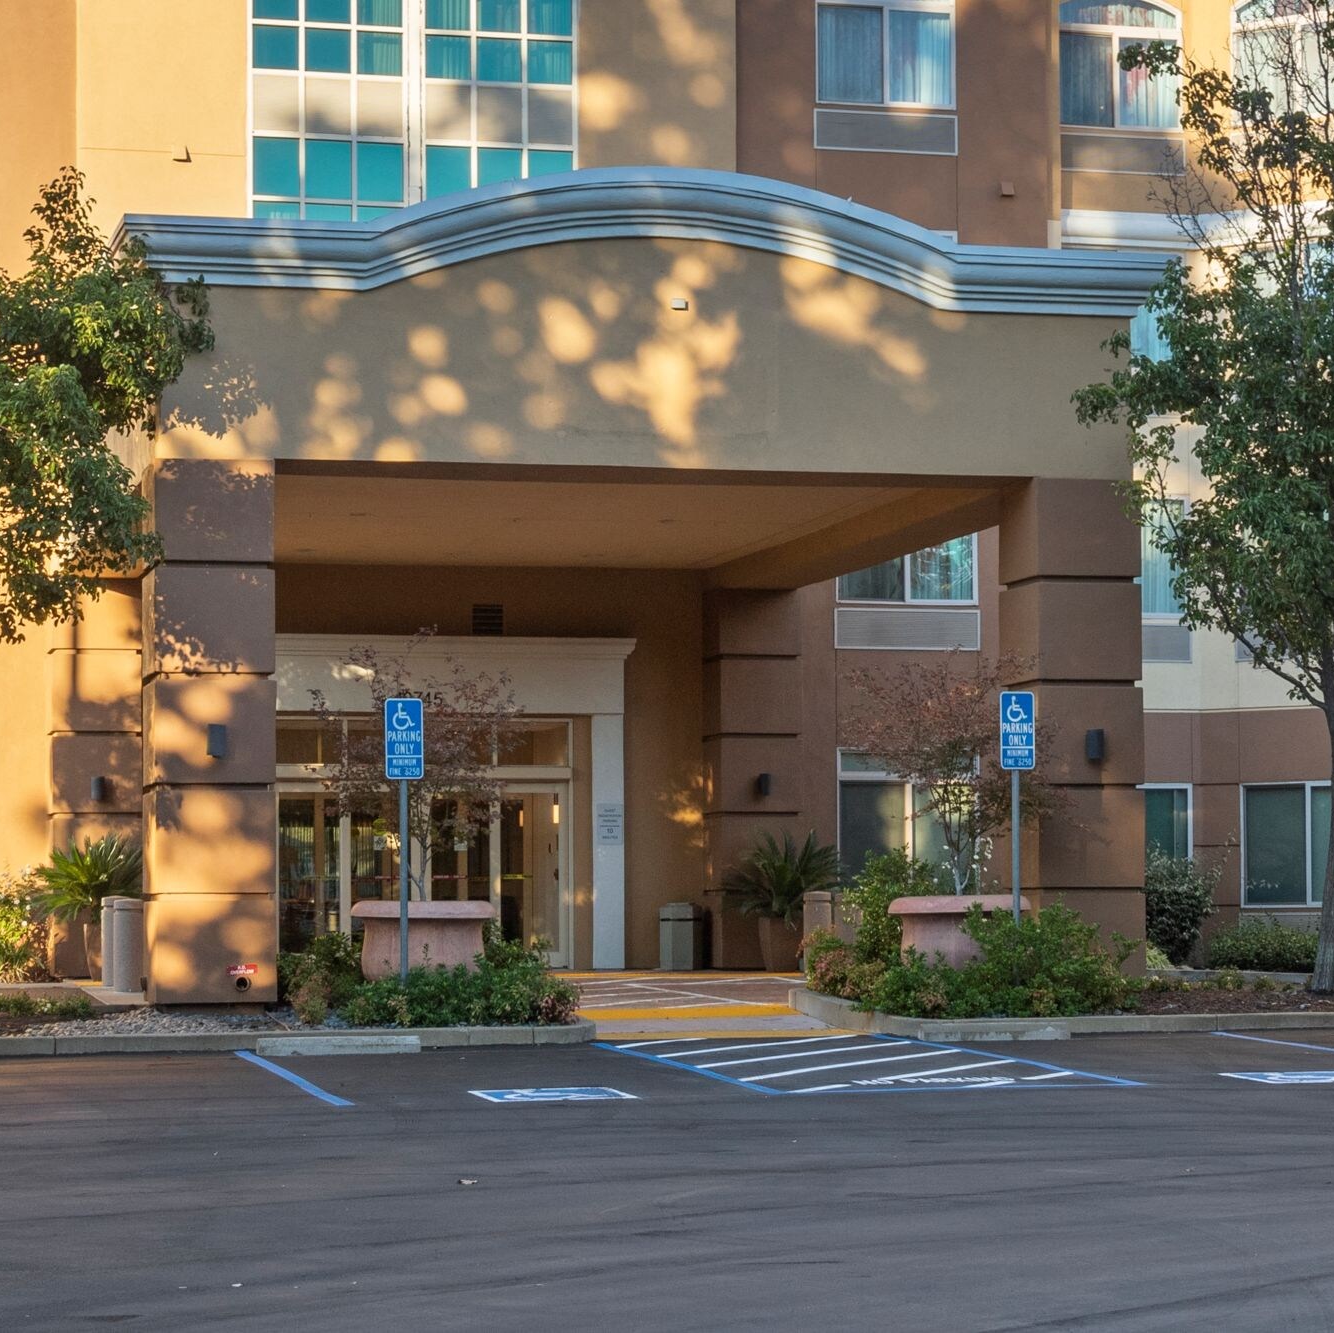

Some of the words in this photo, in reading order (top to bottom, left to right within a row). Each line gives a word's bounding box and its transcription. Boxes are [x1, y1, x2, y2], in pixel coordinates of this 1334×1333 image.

[1002, 722, 1033, 734] PARKING
[387, 730, 421, 742] PARKING
[1008, 735, 1027, 746] ONLY
[394, 743, 415, 755] ONLY
[1006, 749, 1029, 757] MINIMUM
[392, 758, 417, 766] MINIMUM
[1004, 758, 1015, 766] FINE
[1017, 758, 1032, 766] $250
[389, 767, 402, 776] FINE
[404, 766, 420, 776] $250
[851, 1078, 895, 1086] NO
[899, 1076, 1015, 1084] PARKING
